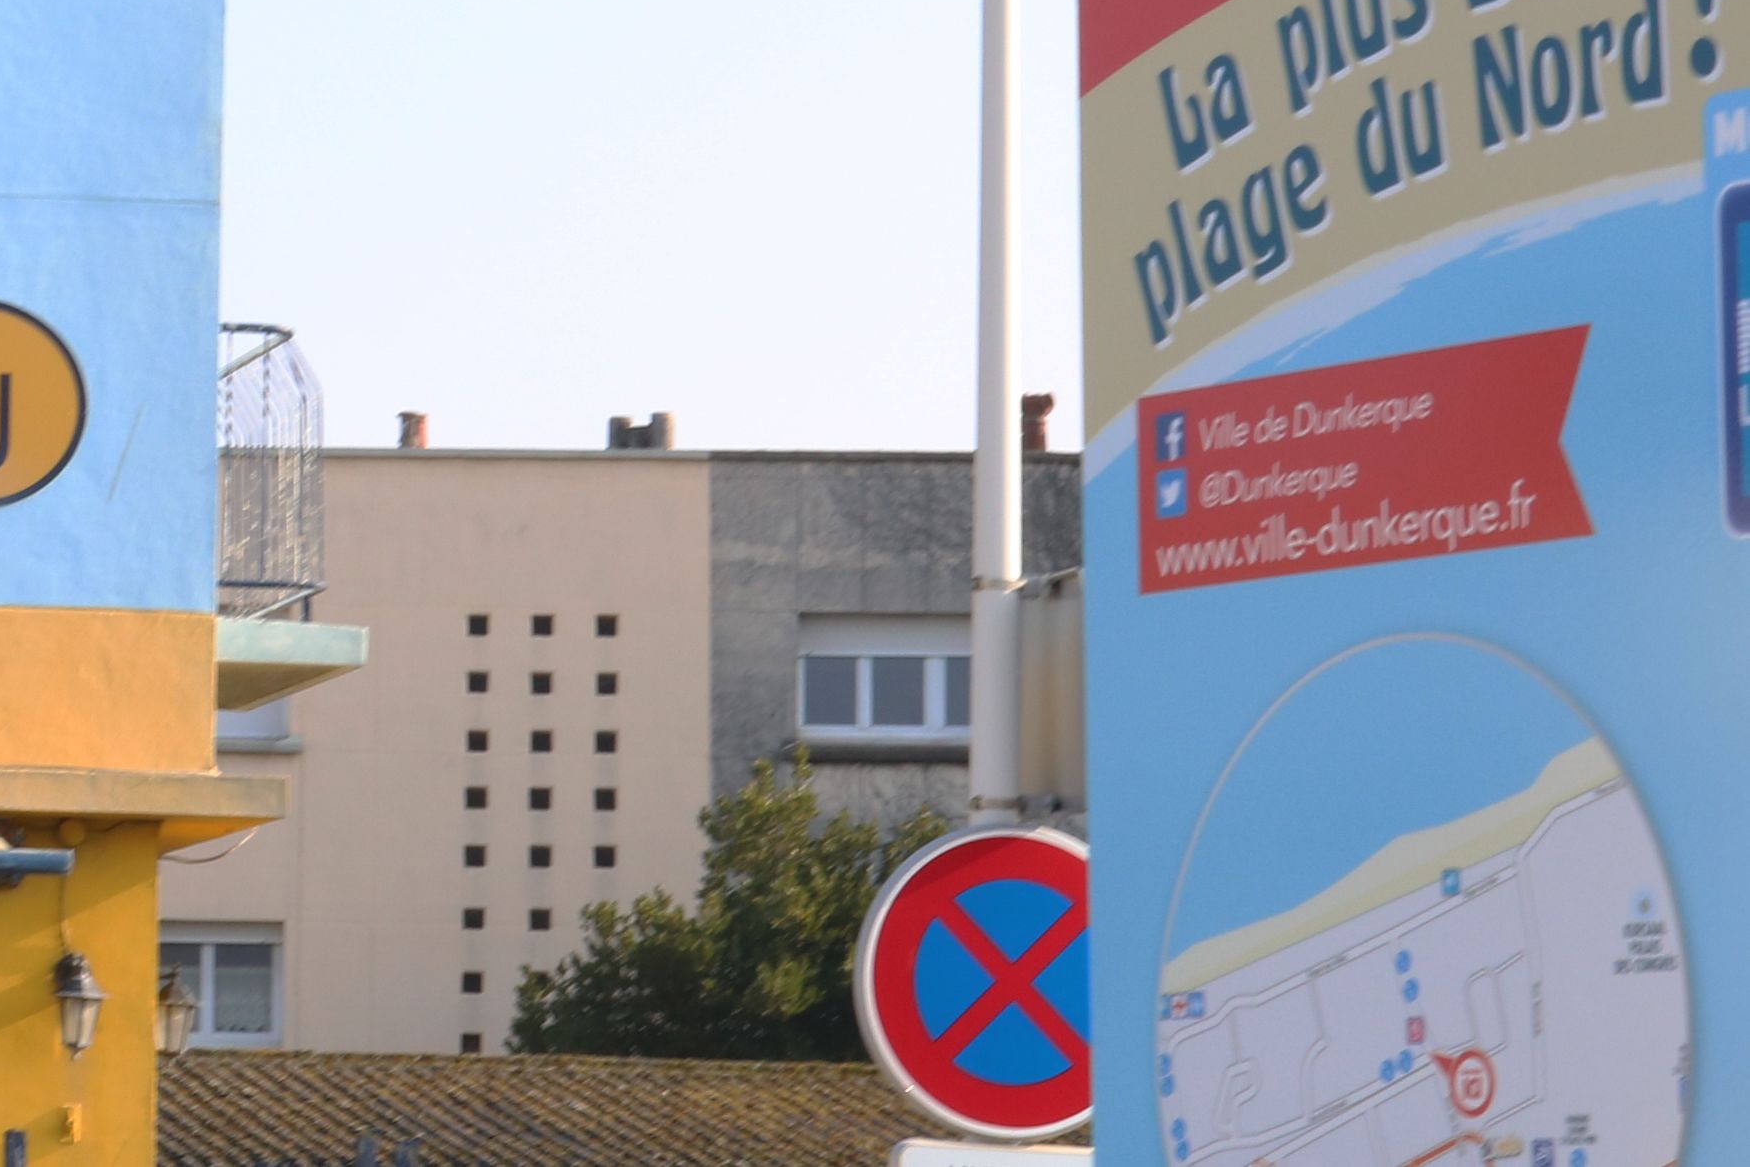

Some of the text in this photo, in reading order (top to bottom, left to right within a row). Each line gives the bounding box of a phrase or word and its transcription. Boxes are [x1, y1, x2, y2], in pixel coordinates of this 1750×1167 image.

[1158, 50, 1254, 175] La
[1133, 142, 1334, 350] plage
[1356, 76, 1450, 202] du
[1198, 391, 1434, 452] Ville de Dunkerque
[1154, 479, 1538, 578] www.ville-dunkerque.fr
[1199, 460, 1359, 509] @Dunkerque
